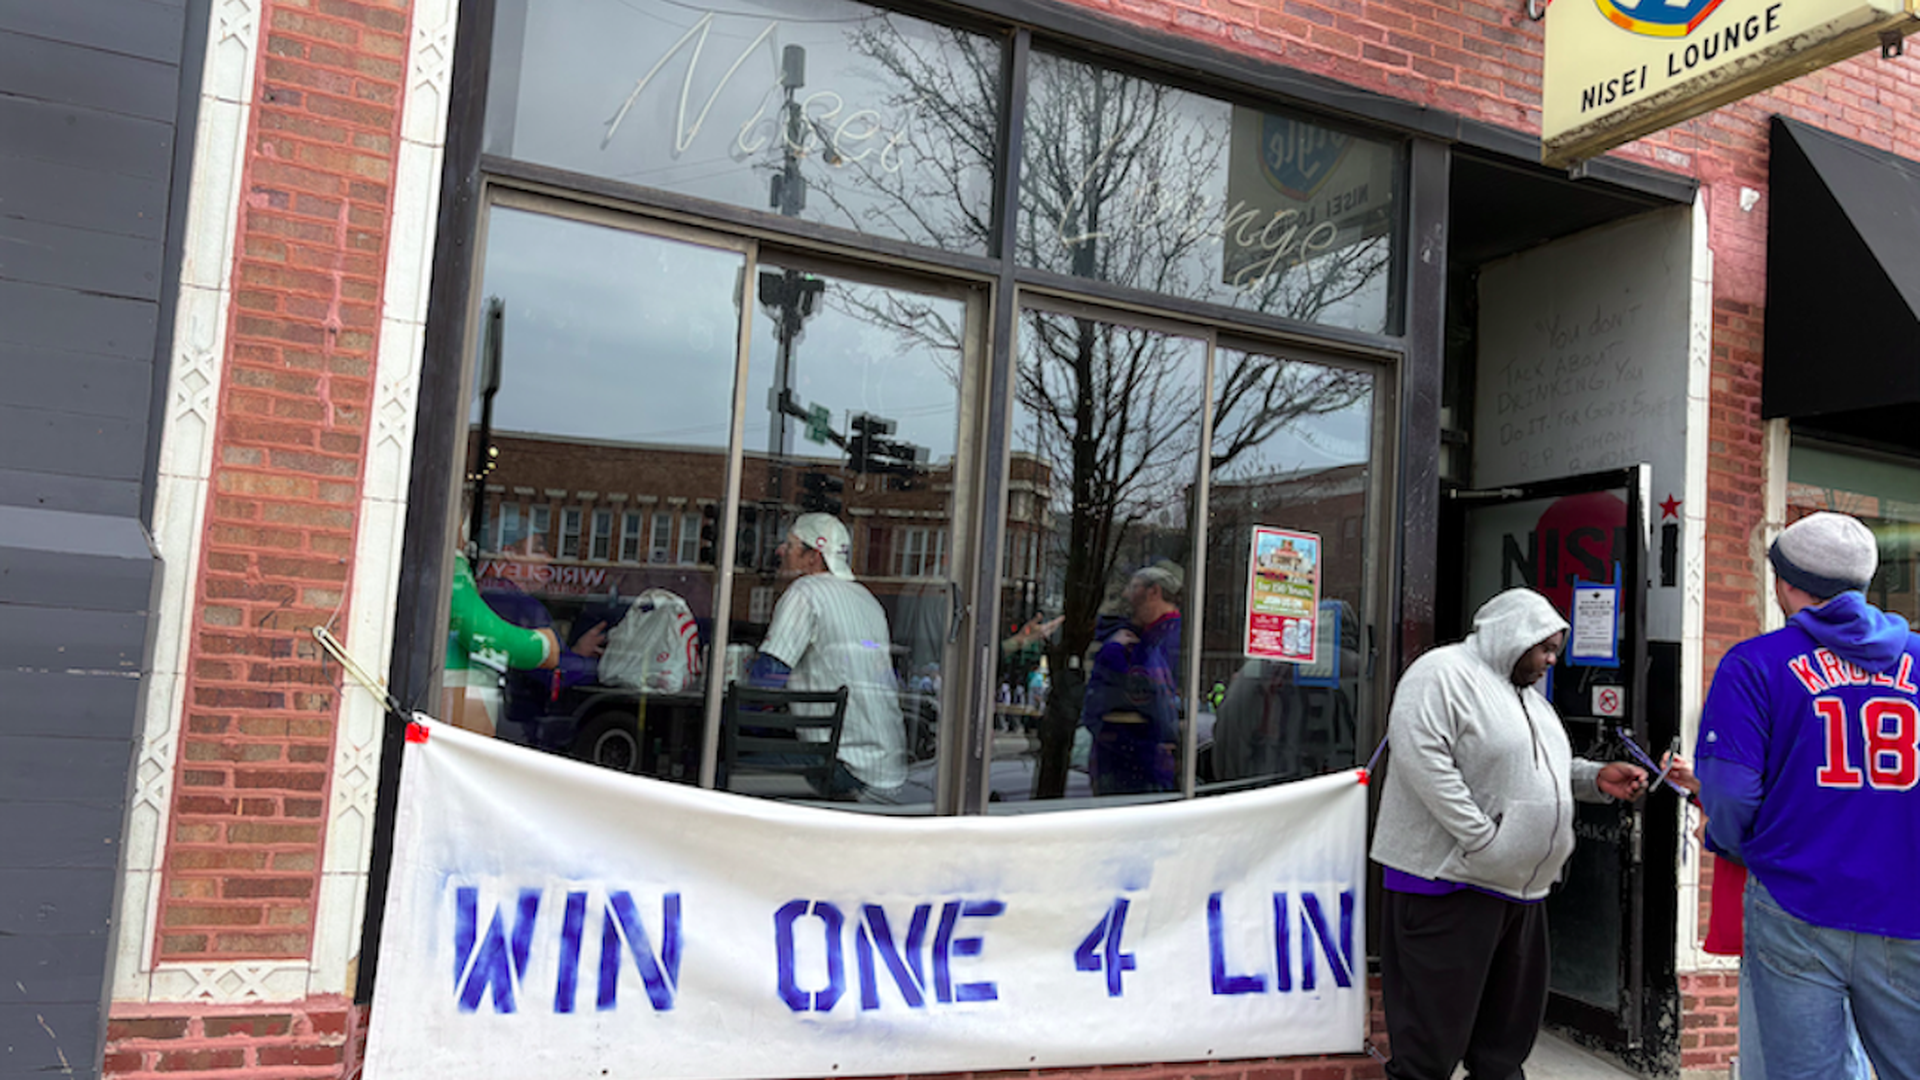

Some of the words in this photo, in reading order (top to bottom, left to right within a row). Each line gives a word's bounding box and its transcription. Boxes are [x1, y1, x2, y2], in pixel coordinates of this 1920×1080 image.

[605, 11, 908, 173] Nisei
[1581, 65, 1647, 112] NISEI
[1667, 2, 1782, 78] LOUNGE
[1813, 696, 1920, 791] 18
[454, 886, 683, 1014] WIN
[773, 899, 1008, 1013] ONE
[1073, 896, 1137, 998] 4
[1206, 888, 1355, 996] LIN
